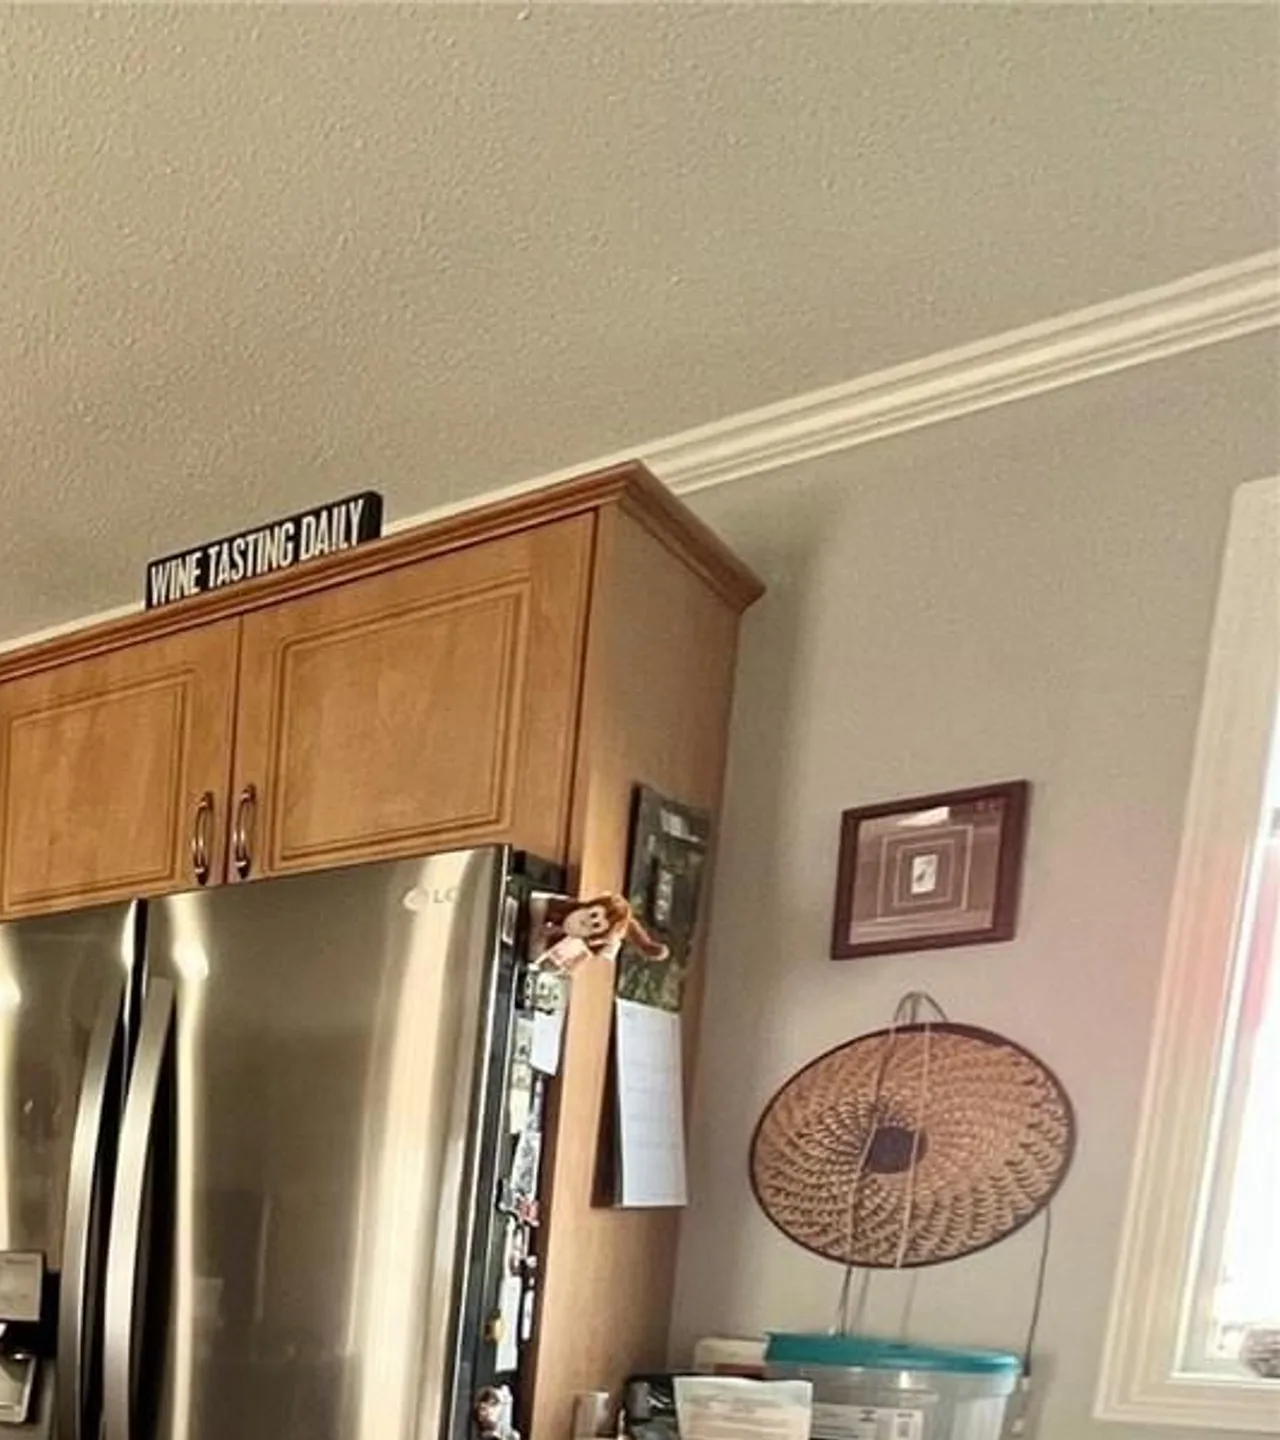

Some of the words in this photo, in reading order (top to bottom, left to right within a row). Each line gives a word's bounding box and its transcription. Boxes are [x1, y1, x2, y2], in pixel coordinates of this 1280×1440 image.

[150, 551, 202, 607] WINE
[207, 521, 295, 588] TASTING
[298, 499, 365, 562] DAILY
